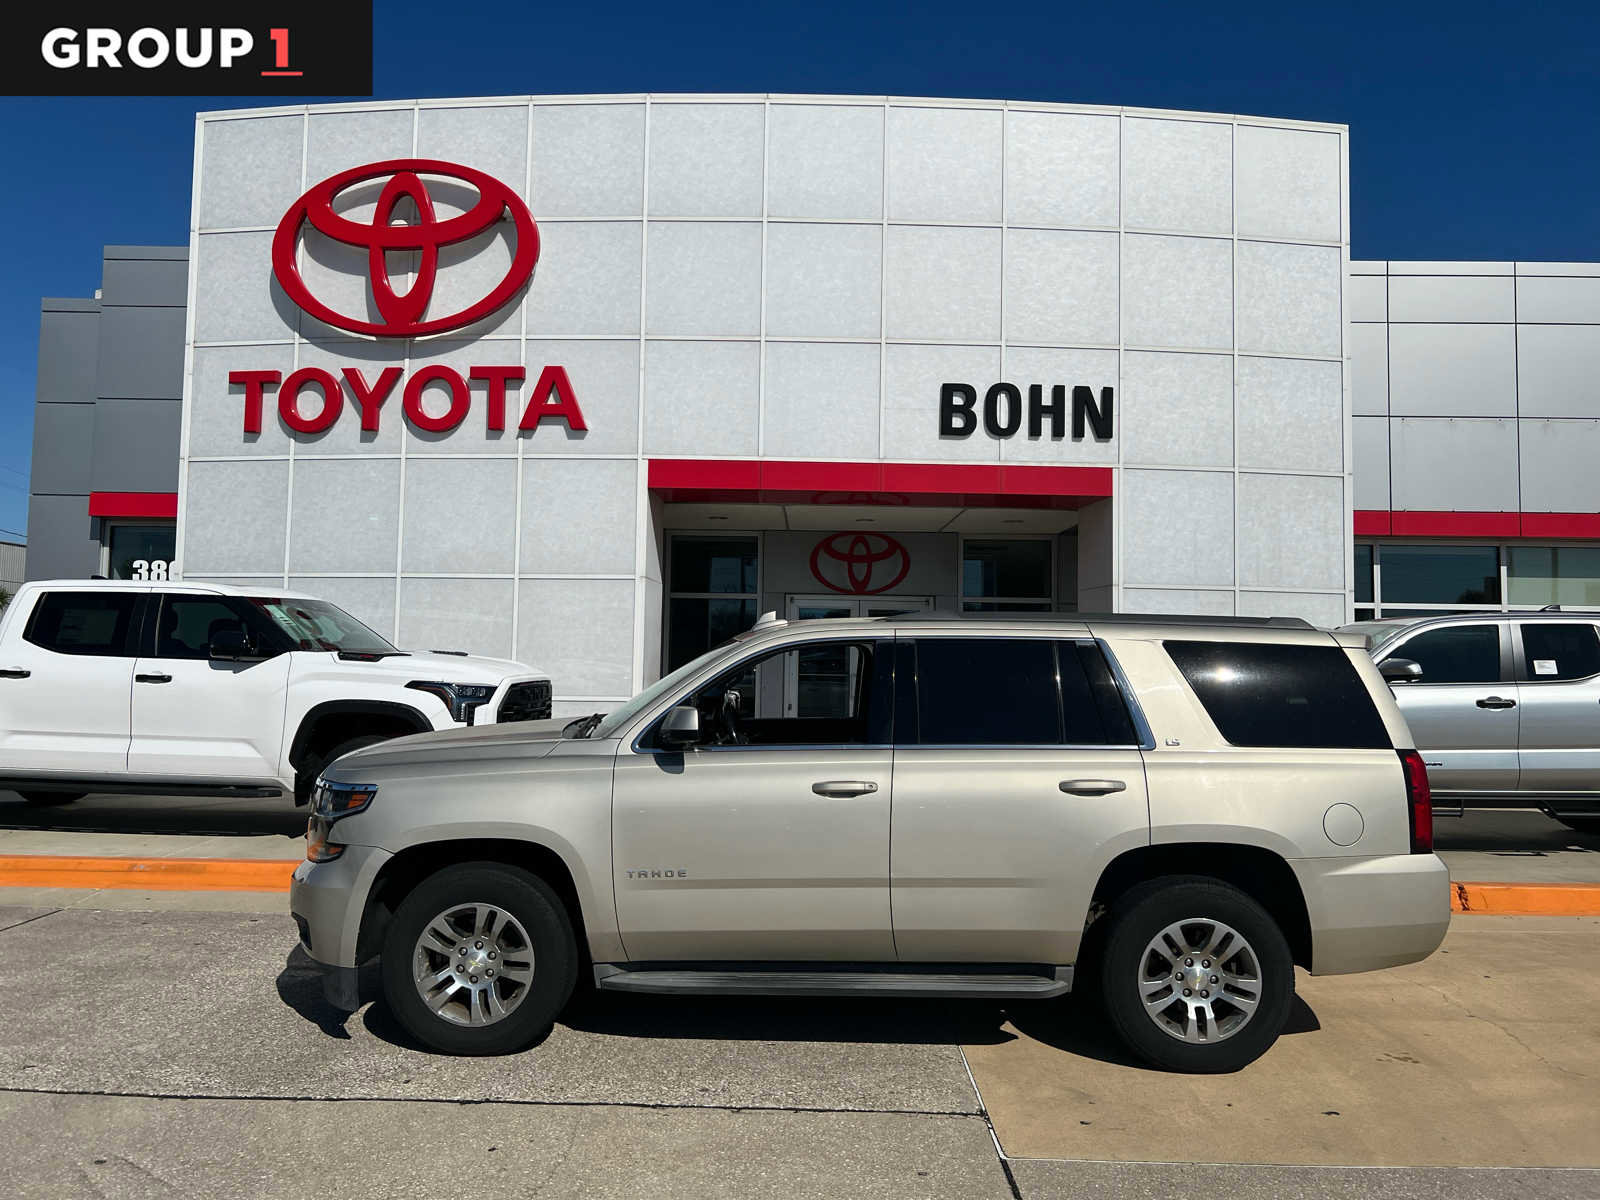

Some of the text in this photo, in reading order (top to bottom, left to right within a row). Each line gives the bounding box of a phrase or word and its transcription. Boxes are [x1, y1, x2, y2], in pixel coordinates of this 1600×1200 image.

[229, 365, 588, 434] TOYOTA
[940, 382, 1114, 440] BOHN
[626, 869, 687, 879] TAHOE
